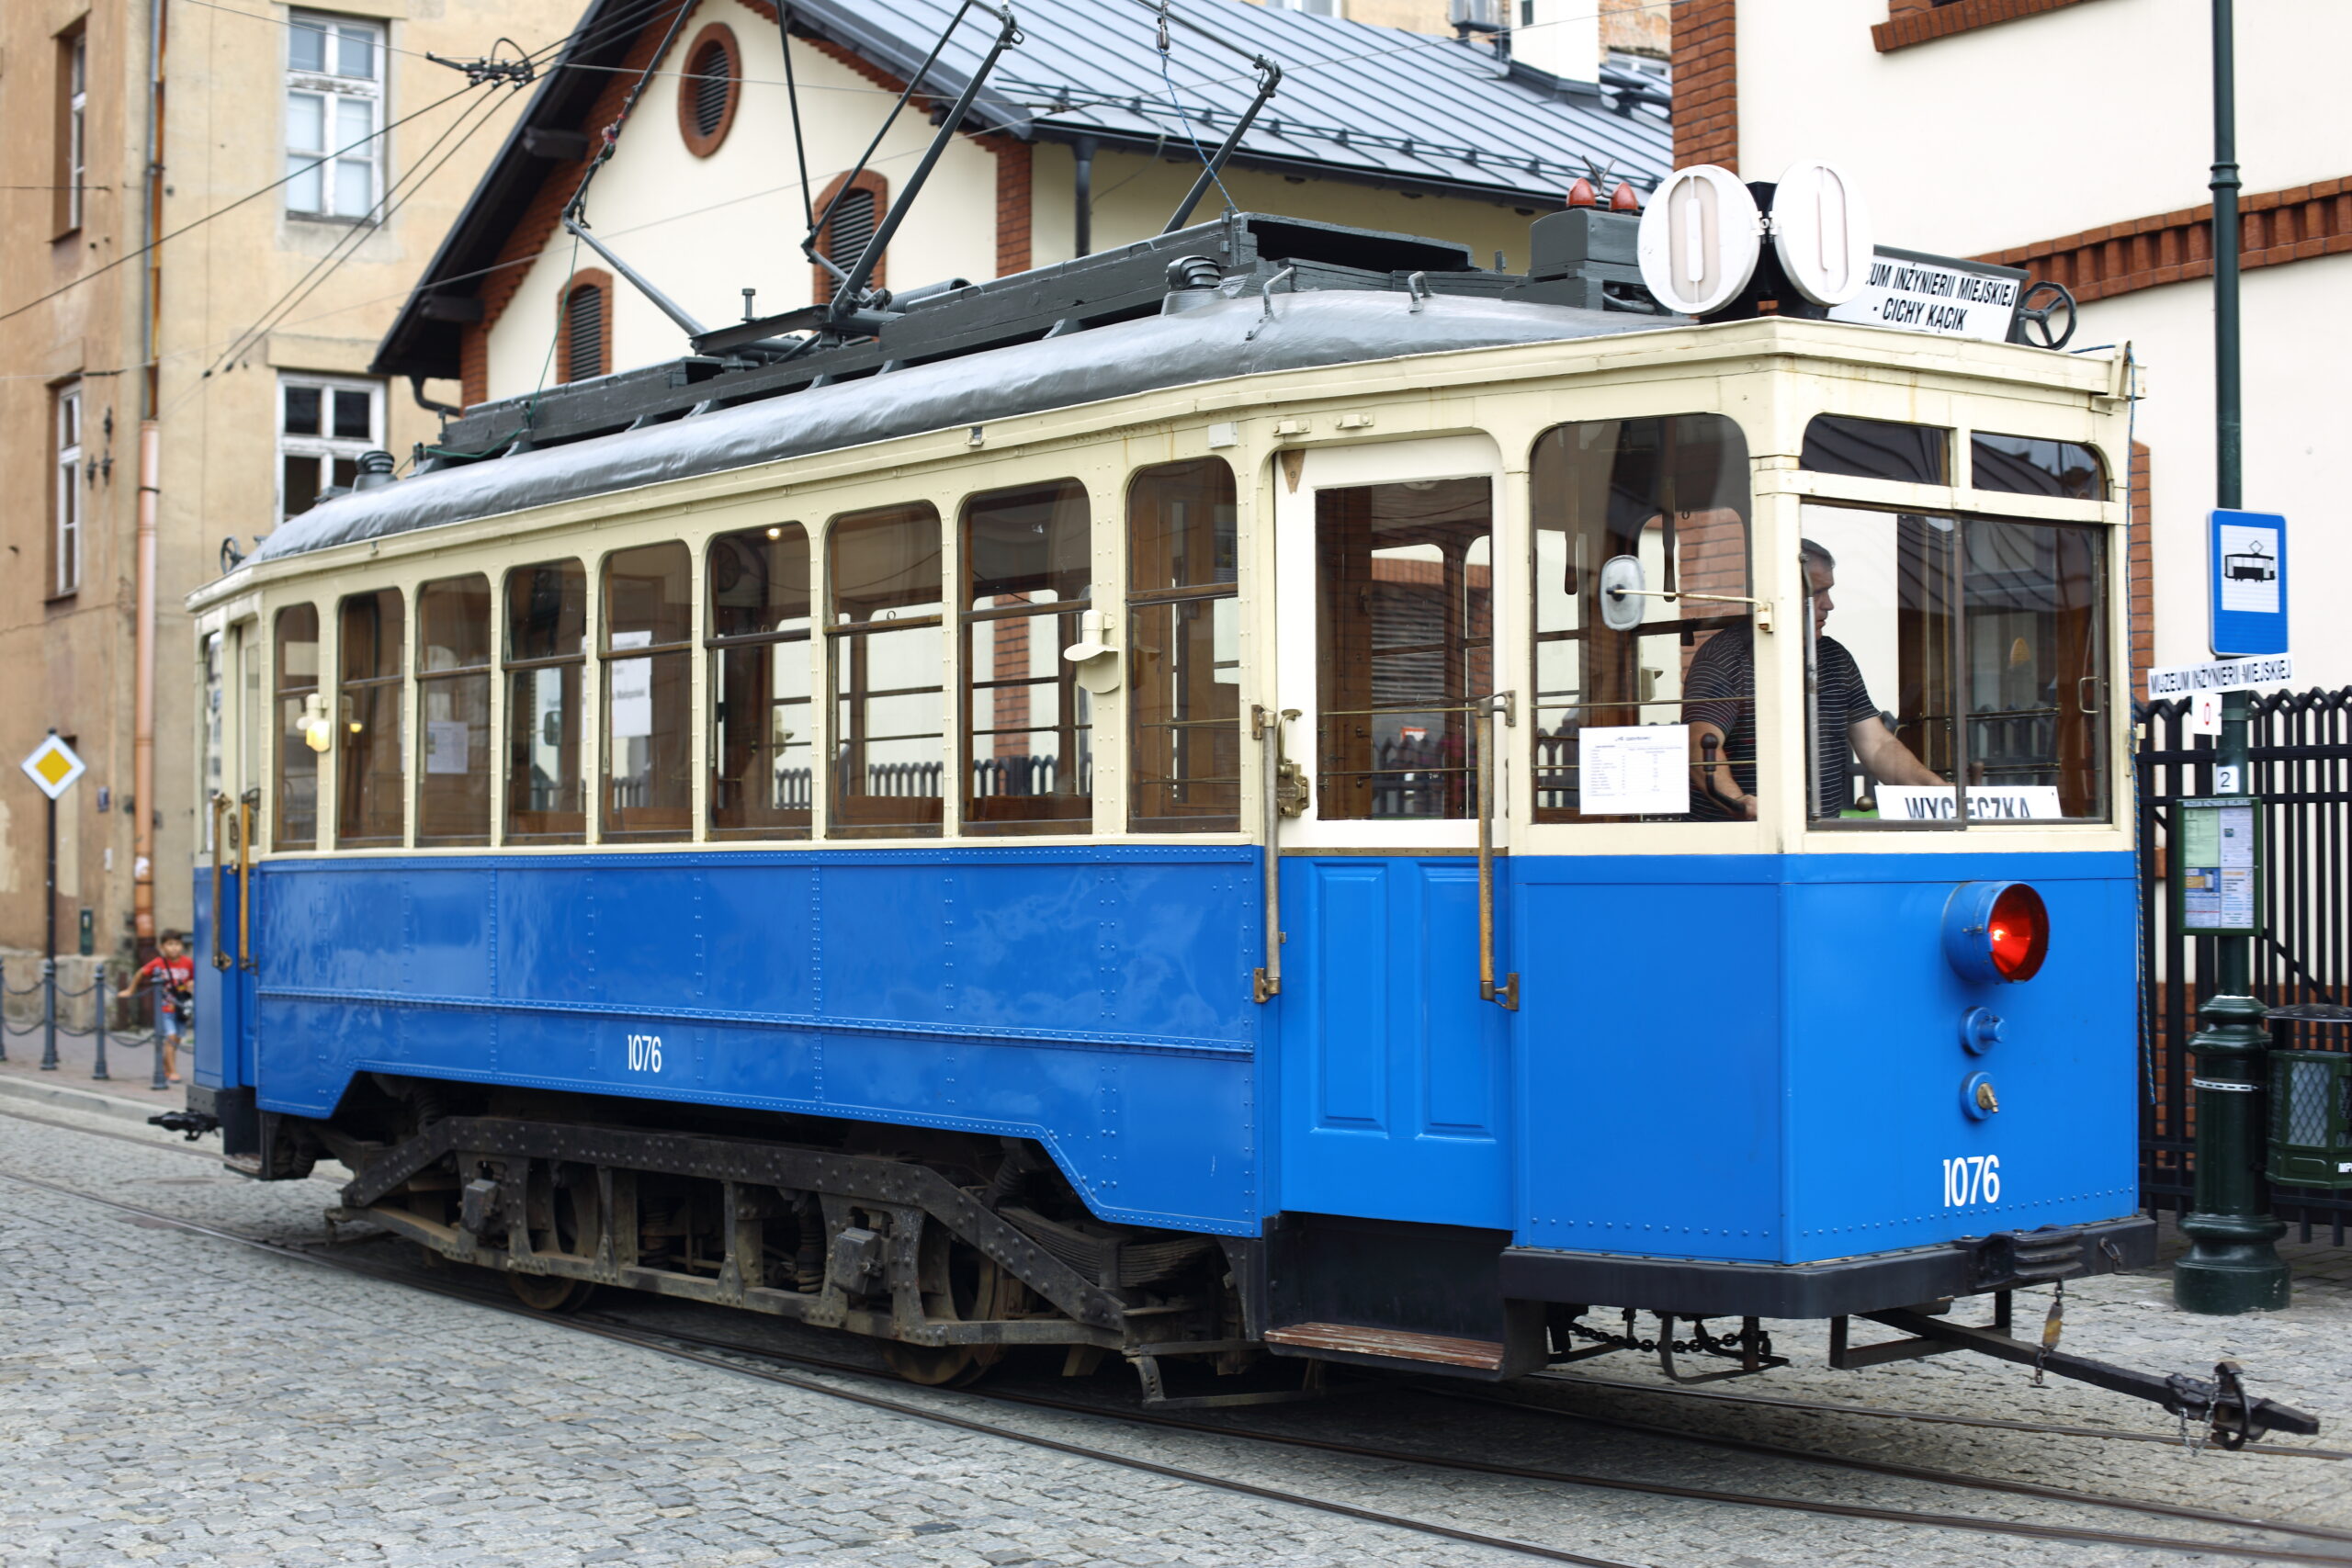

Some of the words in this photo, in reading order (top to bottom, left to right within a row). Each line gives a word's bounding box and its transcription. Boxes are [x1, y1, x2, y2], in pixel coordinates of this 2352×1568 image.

[1866, 263, 1892, 288] UM
[1893, 263, 1956, 299] INŻYNIERII
[1956, 277, 2017, 307] MIEJSKIEJ
[1883, 298, 1925, 324] CICHY
[1926, 304, 1968, 333] KĄCIK
[2220, 772, 2231, 787] 2
[1905, 797, 2030, 818] WYCECZKA
[628, 1034, 662, 1073] 1076
[1943, 1155, 2000, 1207] 1076
